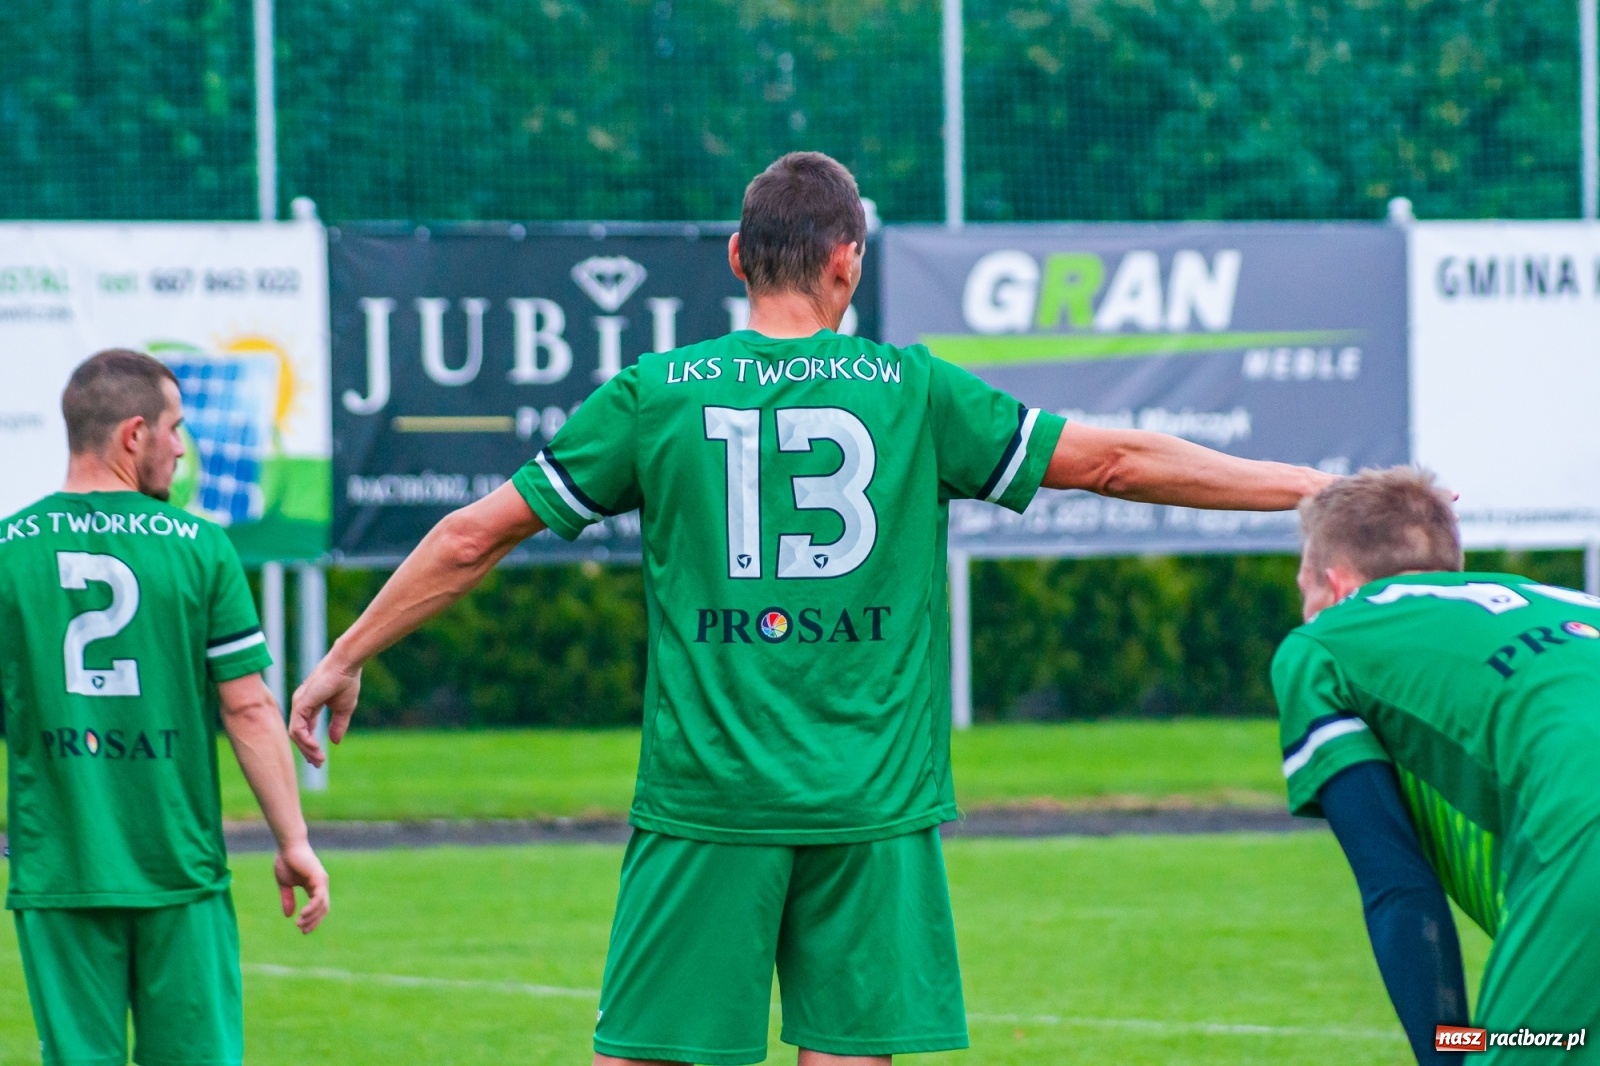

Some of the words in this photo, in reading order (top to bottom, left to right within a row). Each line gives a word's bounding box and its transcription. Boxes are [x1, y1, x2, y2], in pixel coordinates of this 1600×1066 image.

[963, 249, 1242, 334] GRAN
[1436, 256, 1580, 299] GMINA
[666, 357, 722, 384] LKS
[732, 353, 902, 386] TWORKÓW
[702, 405, 879, 580] 13
[47, 511, 199, 540] TWORKÓW
[56, 551, 141, 697] 2
[693, 606, 892, 644] PROSAT
